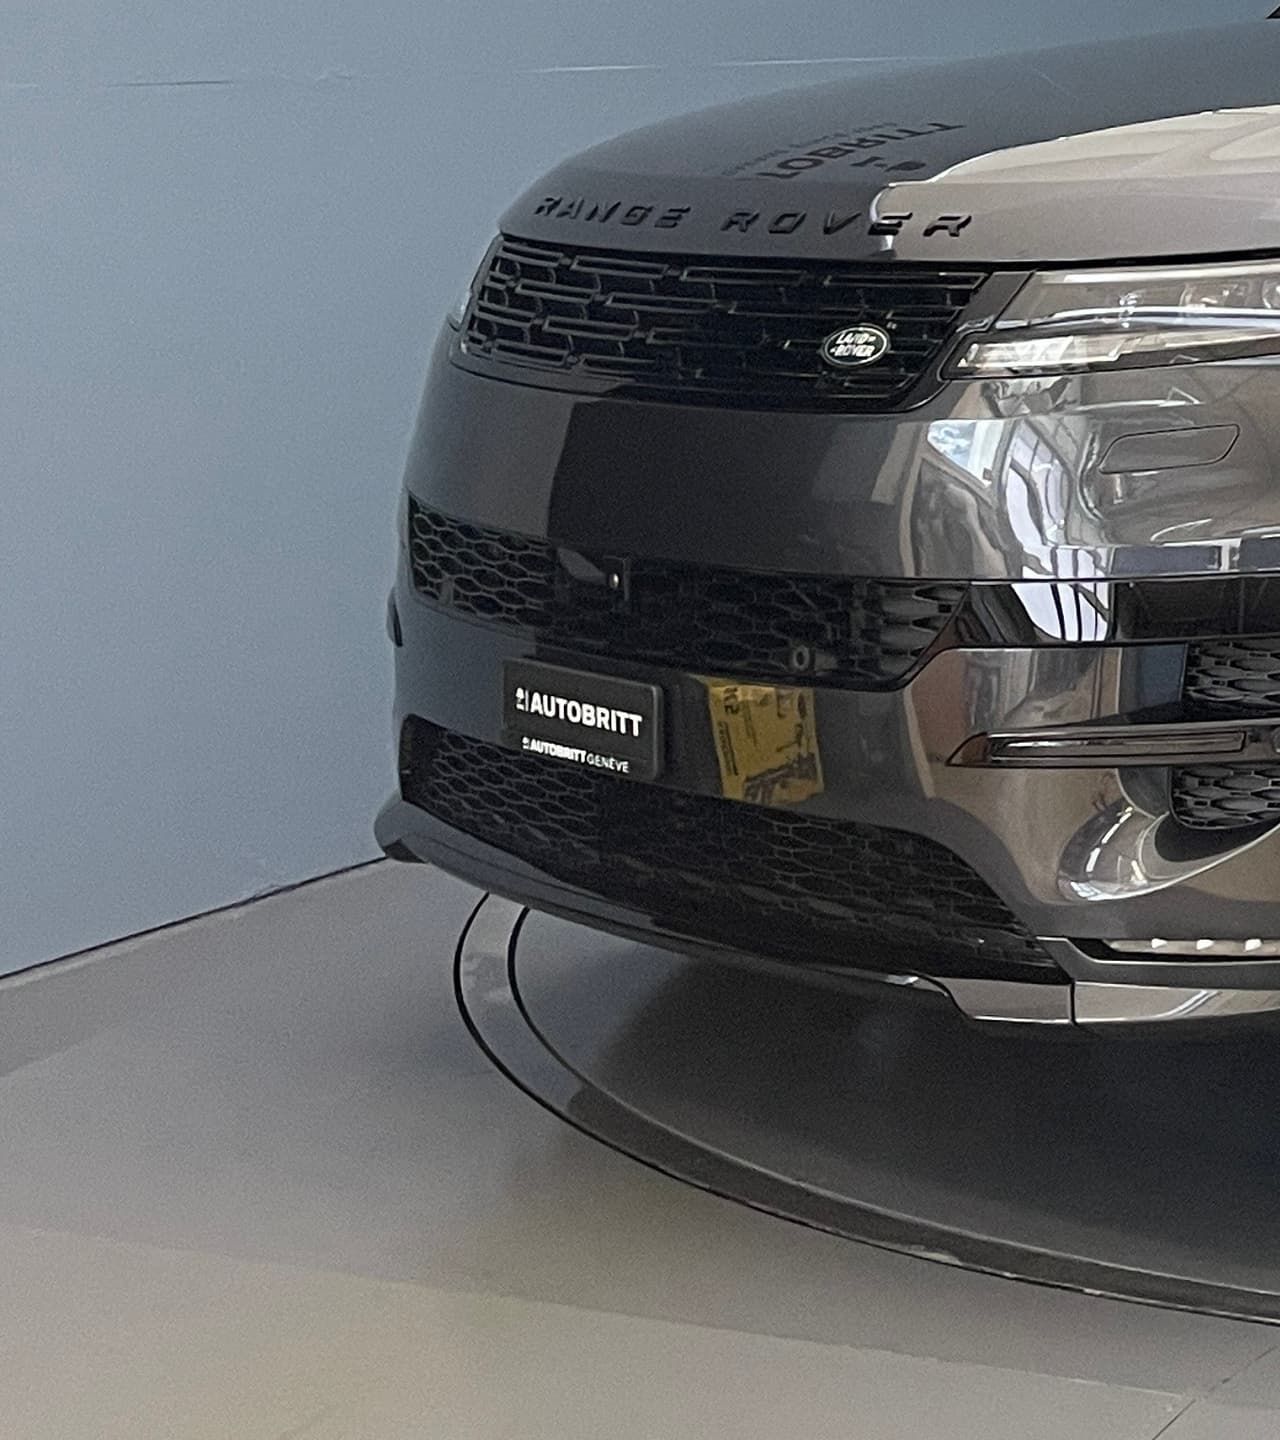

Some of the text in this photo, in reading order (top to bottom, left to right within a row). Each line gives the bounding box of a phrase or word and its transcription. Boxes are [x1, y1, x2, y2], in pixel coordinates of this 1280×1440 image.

[533, 195, 974, 238] RANGE ROVER
[833, 344, 876, 357] ROVER
[835, 332, 870, 345] LAND
[530, 691, 643, 737] AUTOBRITT
[529, 738, 587, 764] AUTOBRITT
